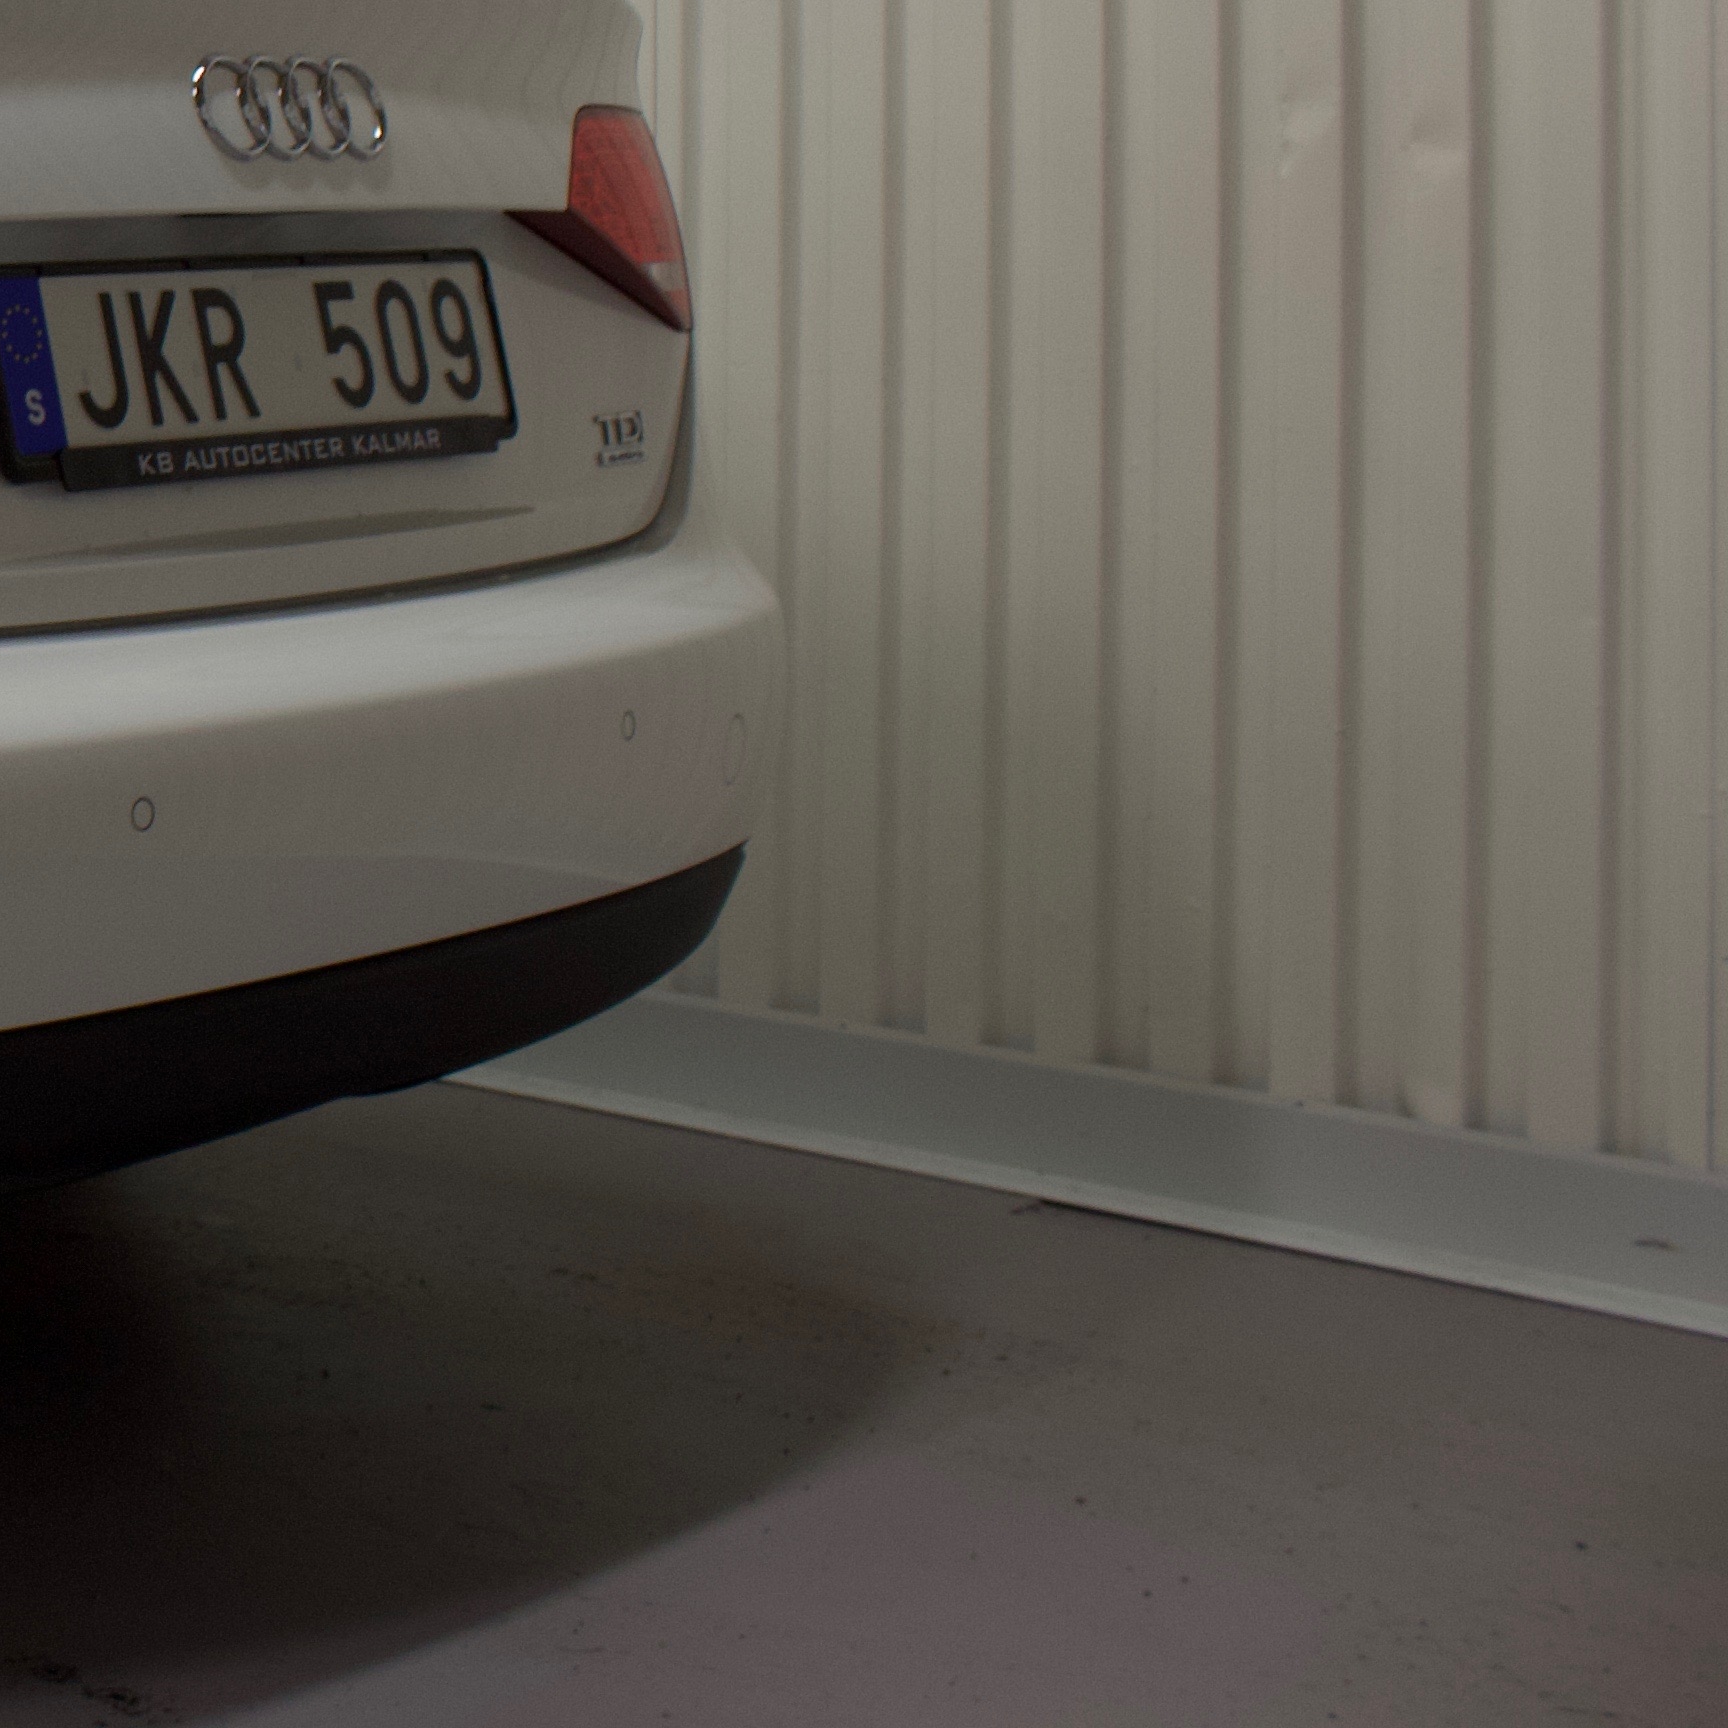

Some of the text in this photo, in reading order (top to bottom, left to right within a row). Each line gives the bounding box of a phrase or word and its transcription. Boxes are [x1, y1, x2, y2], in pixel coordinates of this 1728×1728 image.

[78, 278, 483, 430] JKR 509
[24, 388, 46, 426] S
[138, 428, 442, 476] KB AUTOCENTER KALMAR
